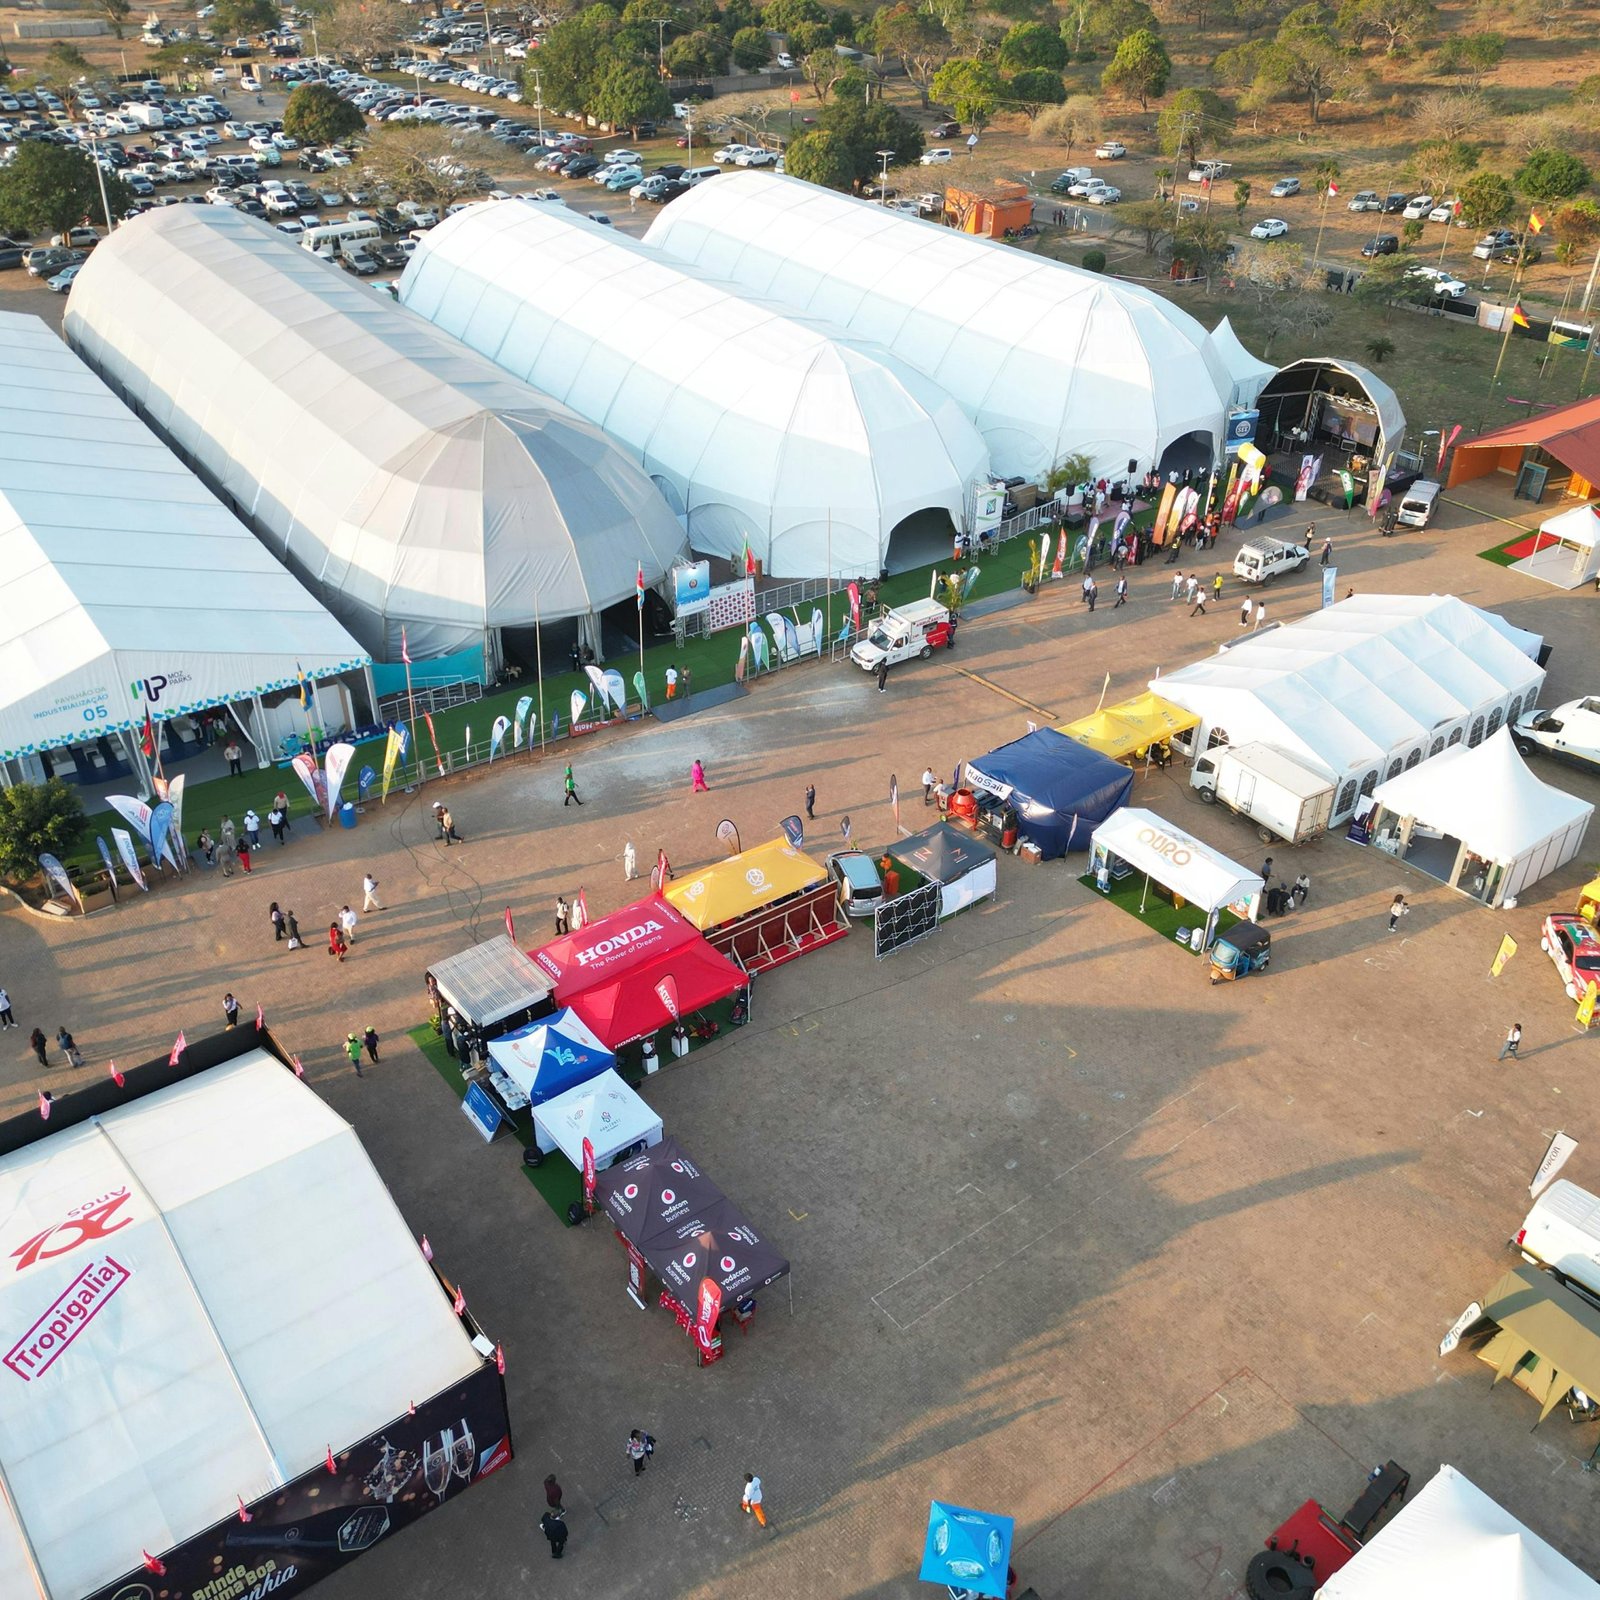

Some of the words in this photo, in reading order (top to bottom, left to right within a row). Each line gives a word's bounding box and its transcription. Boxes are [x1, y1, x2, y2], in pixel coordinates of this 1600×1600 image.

[167, 670, 184, 679] MOZ
[169, 675, 193, 686] PARKS
[33, 693, 109, 719] INDUSTRIALIZAÇÃO
[54, 687, 94, 704] PAVILHÃO
[83, 705, 108, 722] 05
[1137, 828, 1191, 865] OURO
[575, 920, 664, 966] HONDA
[590, 960, 604, 970] The
[605, 951, 627, 964] Power
[628, 945, 636, 953] of
[636, 934, 662, 949] Dreams
[537, 952, 562, 978] HONDA
[614, 1033, 642, 1049] HONDA
[1541, 1146, 1561, 1174] TOPCON
[67, 1185, 127, 1218] Anos
[609, 1196, 626, 1216] business
[613, 1190, 632, 1213] vodacom
[661, 1200, 689, 1217] vodacom
[666, 1207, 690, 1223] business
[665, 1266, 683, 1285] business
[671, 1260, 691, 1282] vodacom
[720, 1266, 750, 1286] vodacom
[726, 1274, 751, 1292] business
[14, 1260, 119, 1369] Tropigalia
[191, 1564, 247, 1600] Brinde
[244, 1559, 277, 1586] Boa
